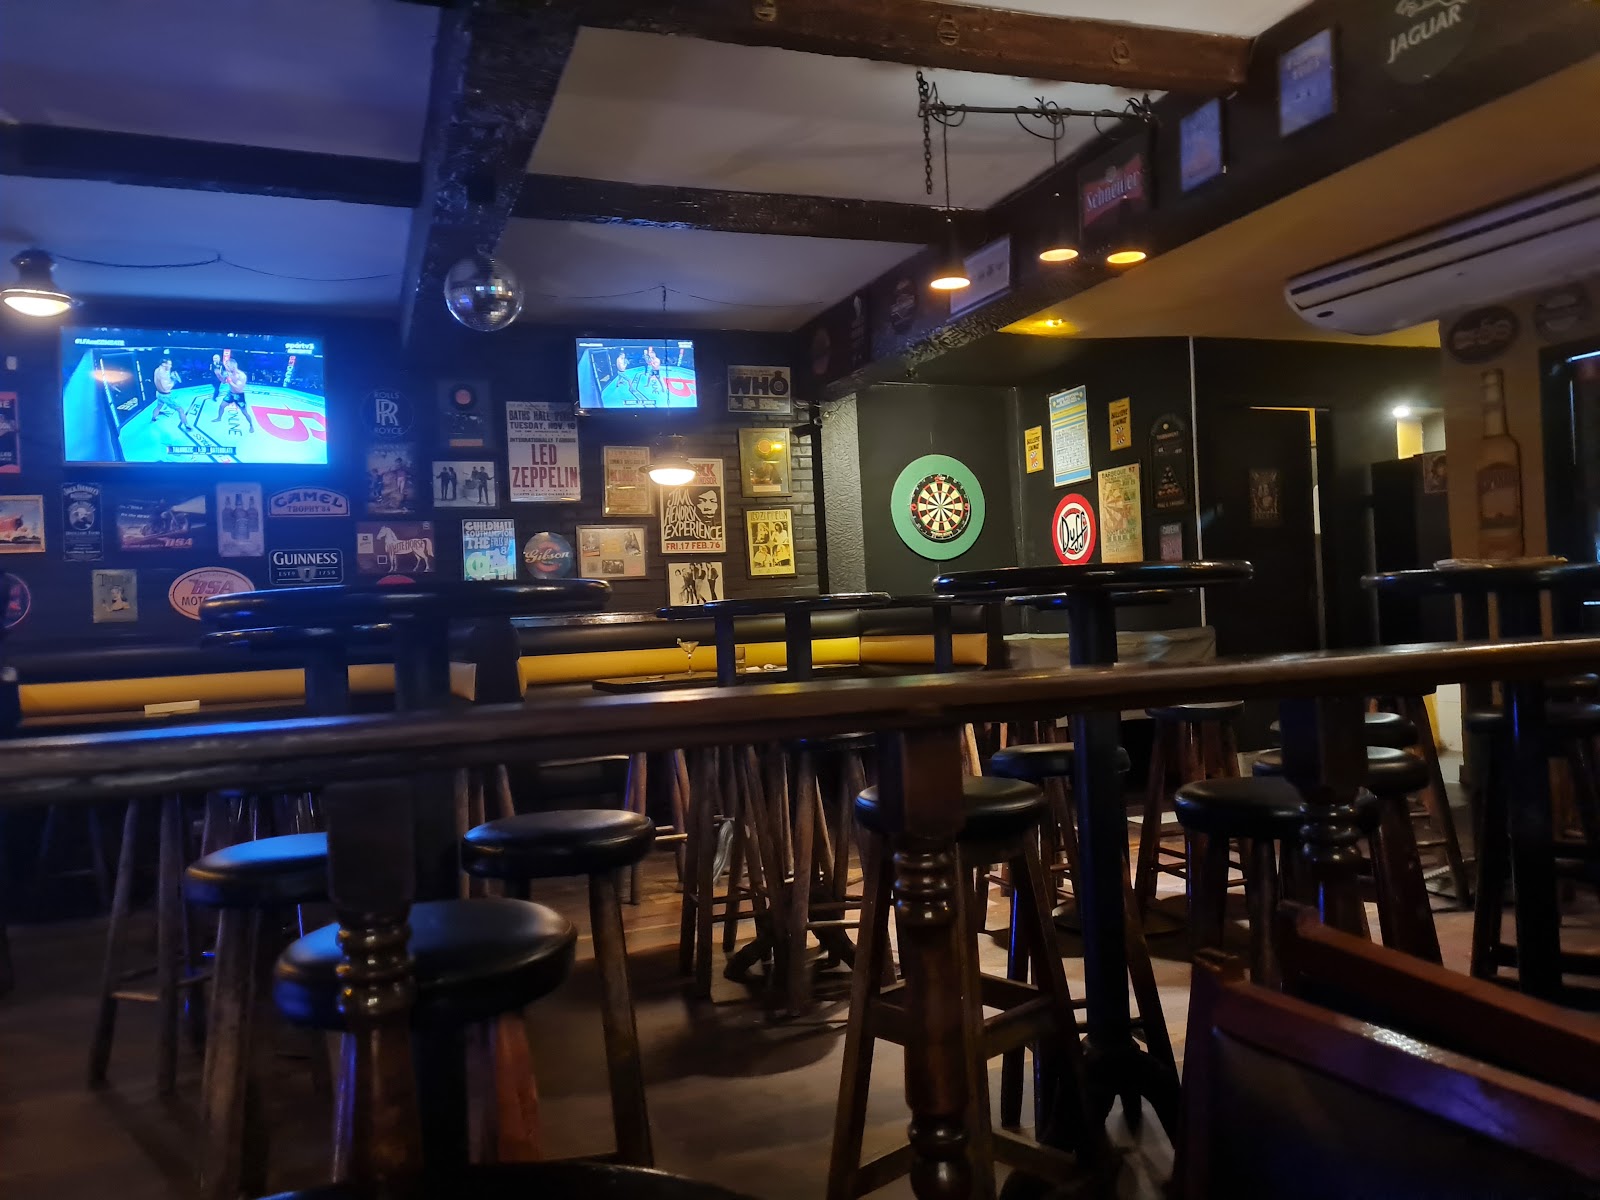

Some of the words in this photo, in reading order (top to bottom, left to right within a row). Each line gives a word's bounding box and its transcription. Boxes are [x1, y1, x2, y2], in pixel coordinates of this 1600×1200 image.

[1387, 4, 1462, 64] JAGUAR
[729, 374, 789, 396] WHO
[373, 391, 400, 399] ROLLS
[508, 410, 531, 421] BATHS
[373, 427, 403, 435] ROYCE
[509, 421, 546, 430] TUESDAY,
[531, 444, 557, 466] LED
[511, 466, 578, 488] ZEPPELIN
[274, 491, 343, 508] CAMEL
[668, 488, 695, 507] JIMI
[465, 521, 513, 531] GUILDHALL
[664, 520, 723, 541] EXPERIENCE
[1061, 511, 1087, 555] Duff
[465, 536, 491, 549] THE
[273, 551, 338, 565] GUINNESS
[525, 549, 570, 563] Gibson
[188, 579, 234, 595] BSA
